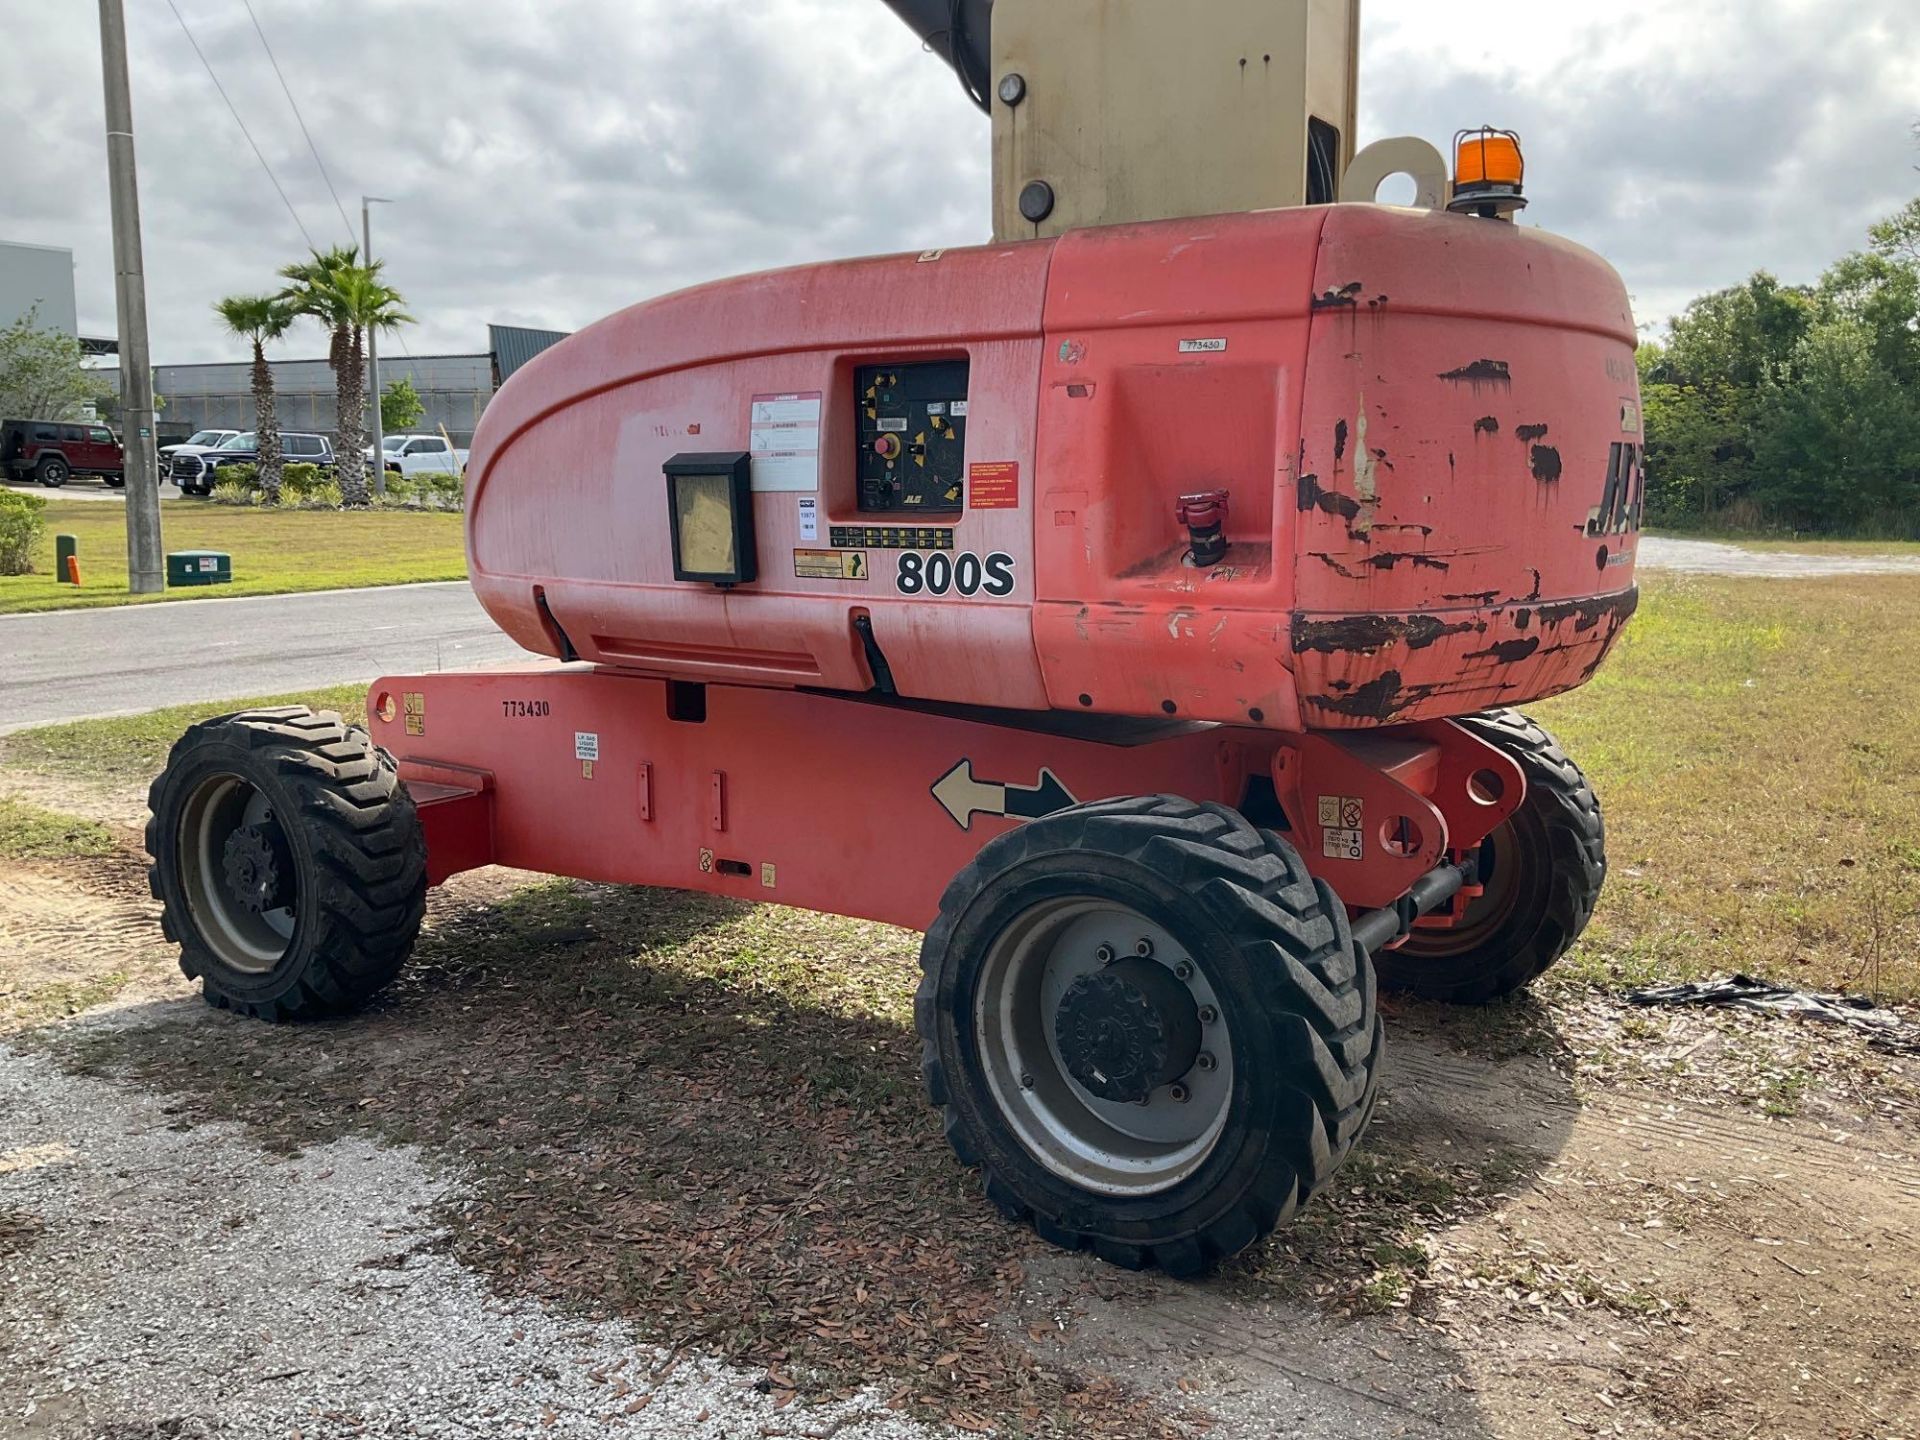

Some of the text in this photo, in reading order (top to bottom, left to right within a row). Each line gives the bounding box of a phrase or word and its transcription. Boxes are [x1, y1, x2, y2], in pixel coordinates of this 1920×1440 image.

[1187, 341, 1220, 350] 773430
[904, 495, 921, 503] JLG
[896, 549, 1016, 597] 800S
[502, 700, 550, 717] 773430
